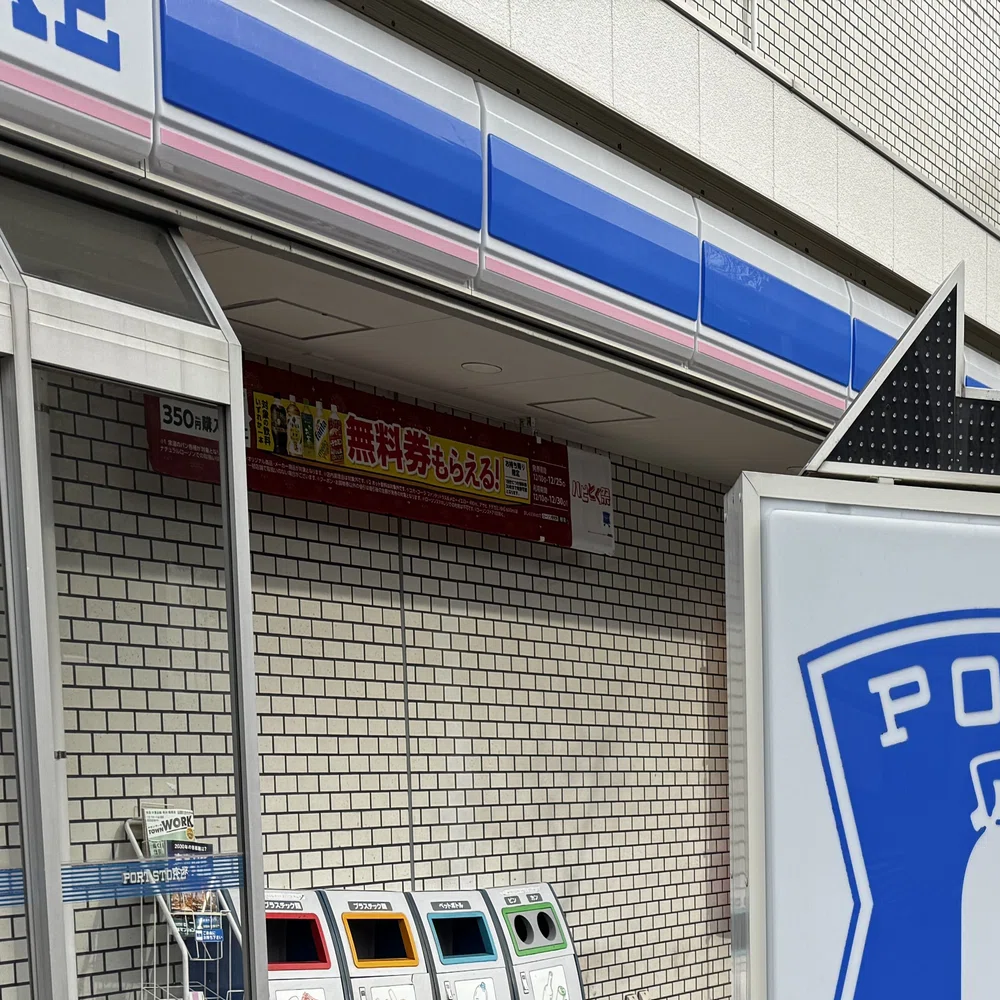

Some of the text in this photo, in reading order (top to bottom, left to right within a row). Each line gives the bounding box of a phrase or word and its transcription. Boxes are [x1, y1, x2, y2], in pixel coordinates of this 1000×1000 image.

[344, 412, 501, 493] 無料券もらえる!
[161, 815, 194, 831] WORK
